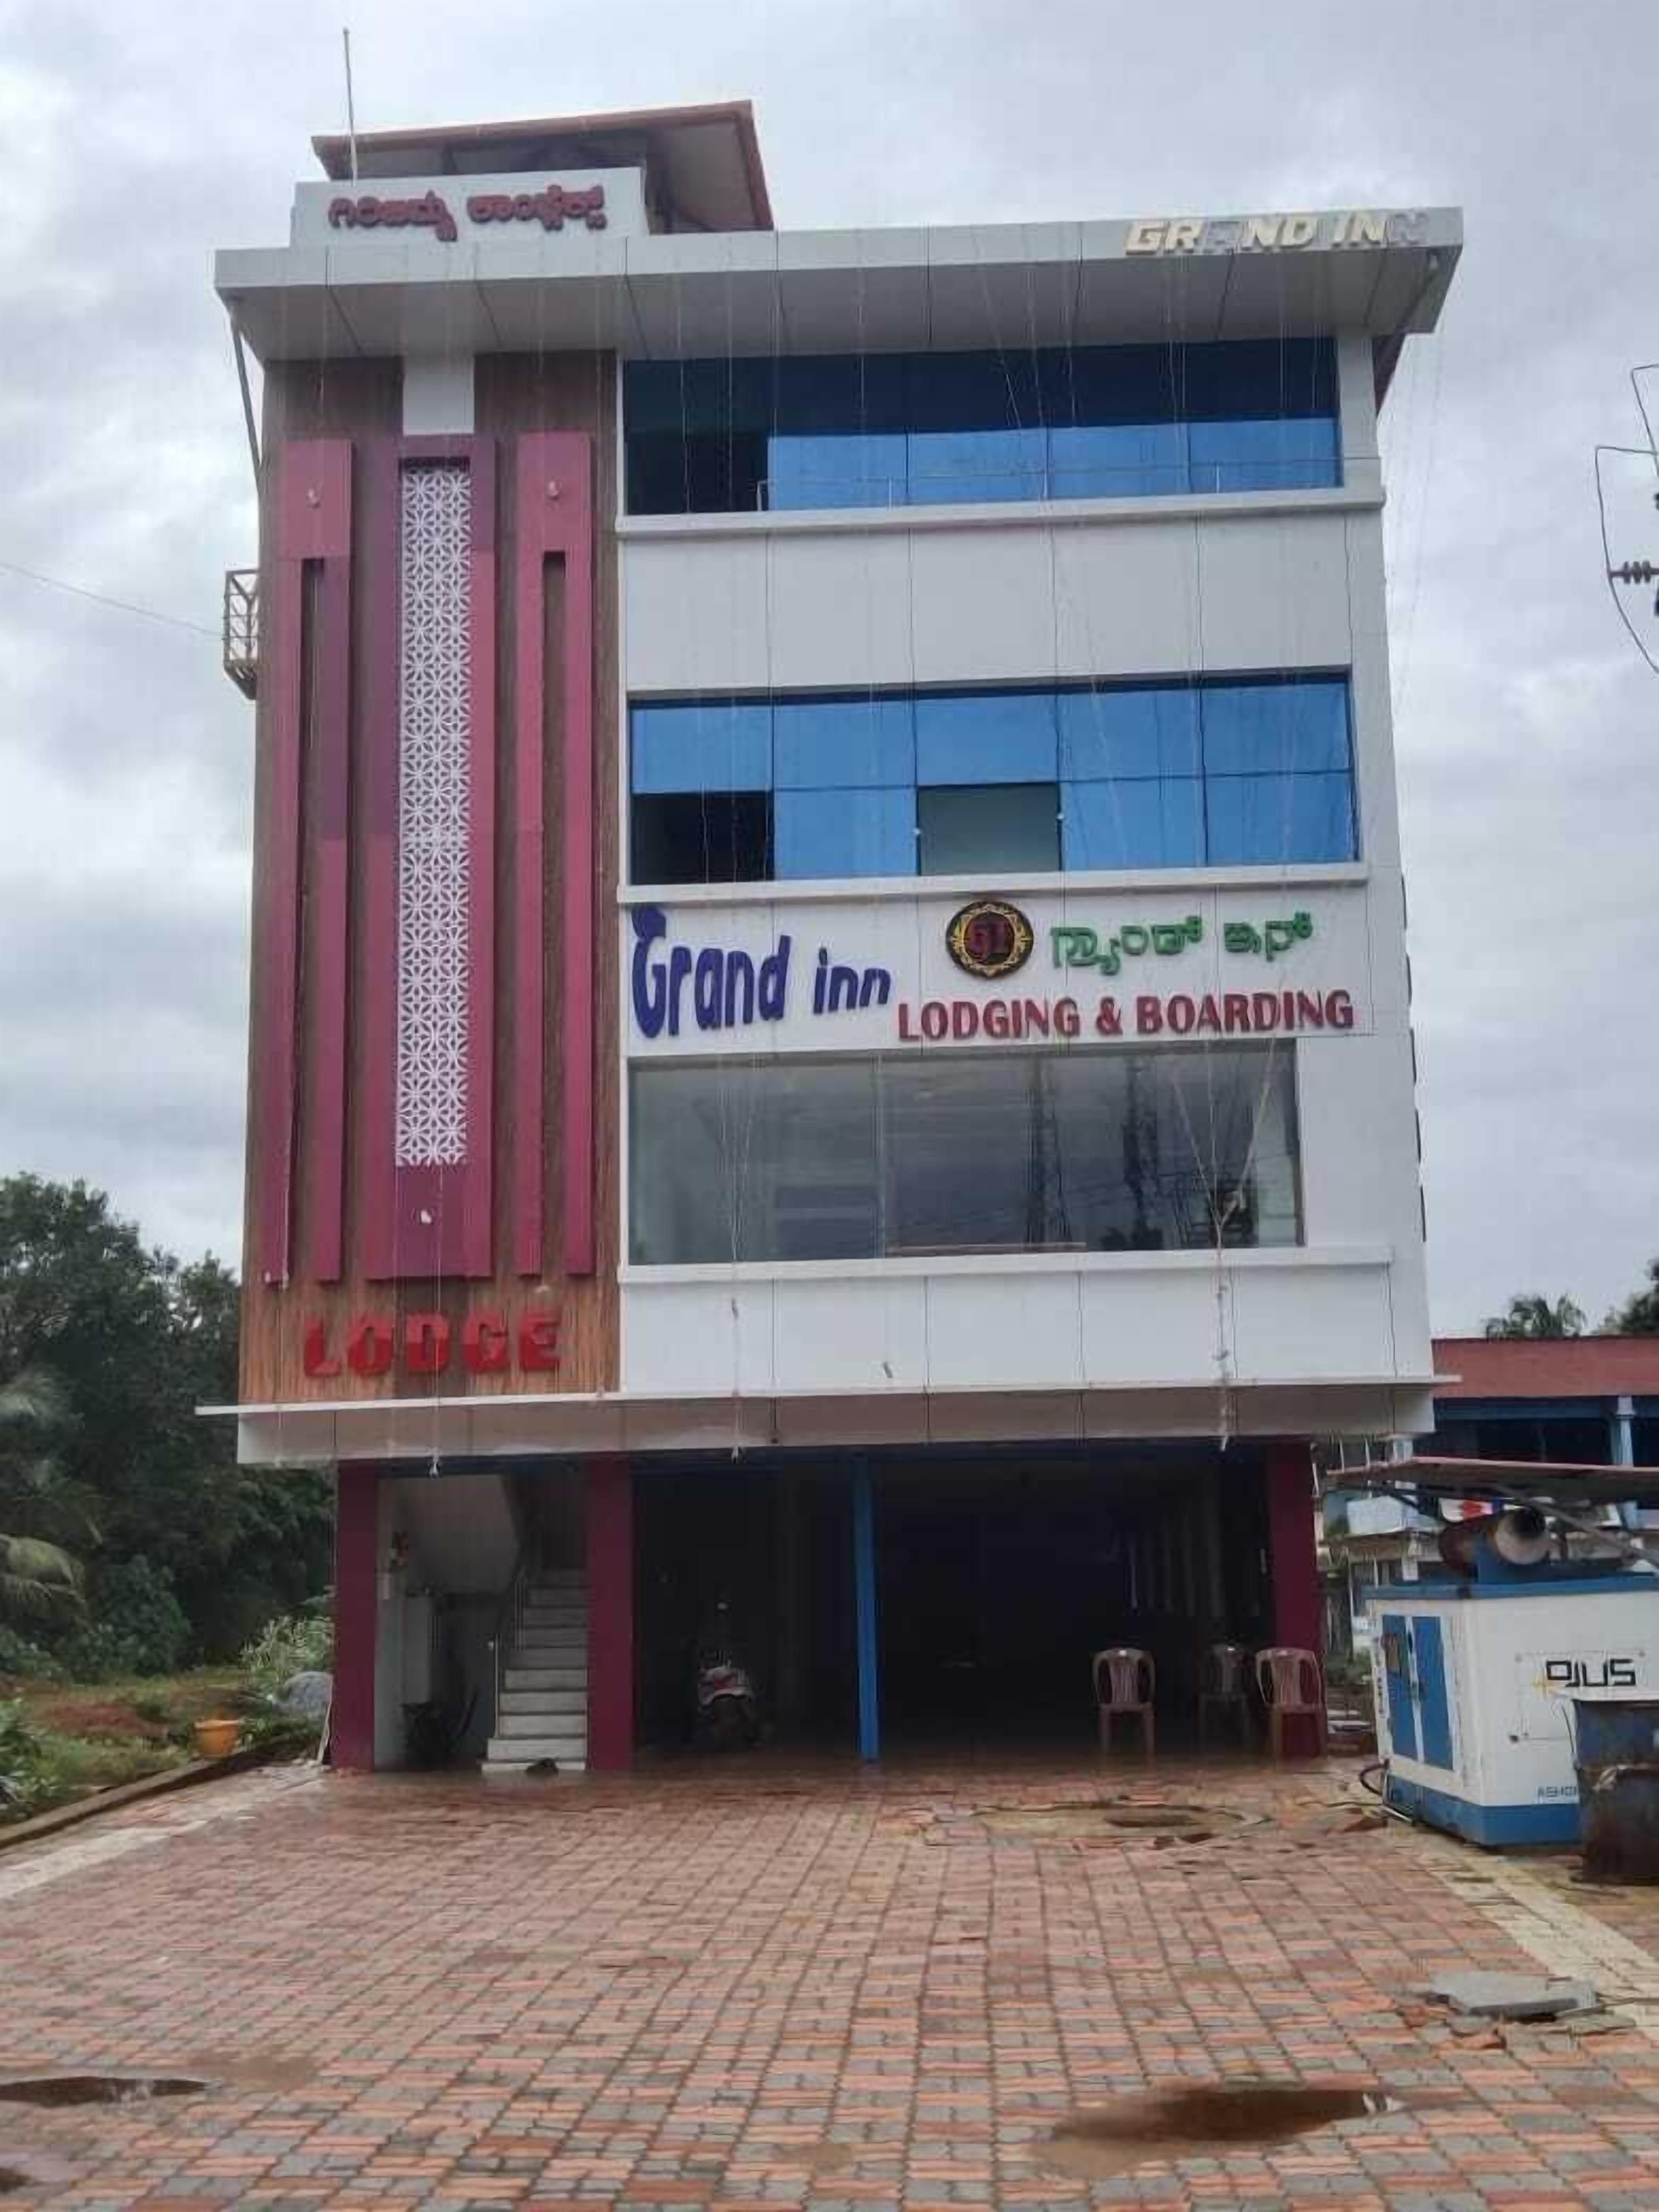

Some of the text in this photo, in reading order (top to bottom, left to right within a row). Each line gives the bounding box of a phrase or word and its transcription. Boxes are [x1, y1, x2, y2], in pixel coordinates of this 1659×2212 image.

[631, 903, 891, 1038] Grand inn
[898, 989, 1354, 1041] LODGING & BOARDING
[304, 1309, 562, 1378] LODGE
